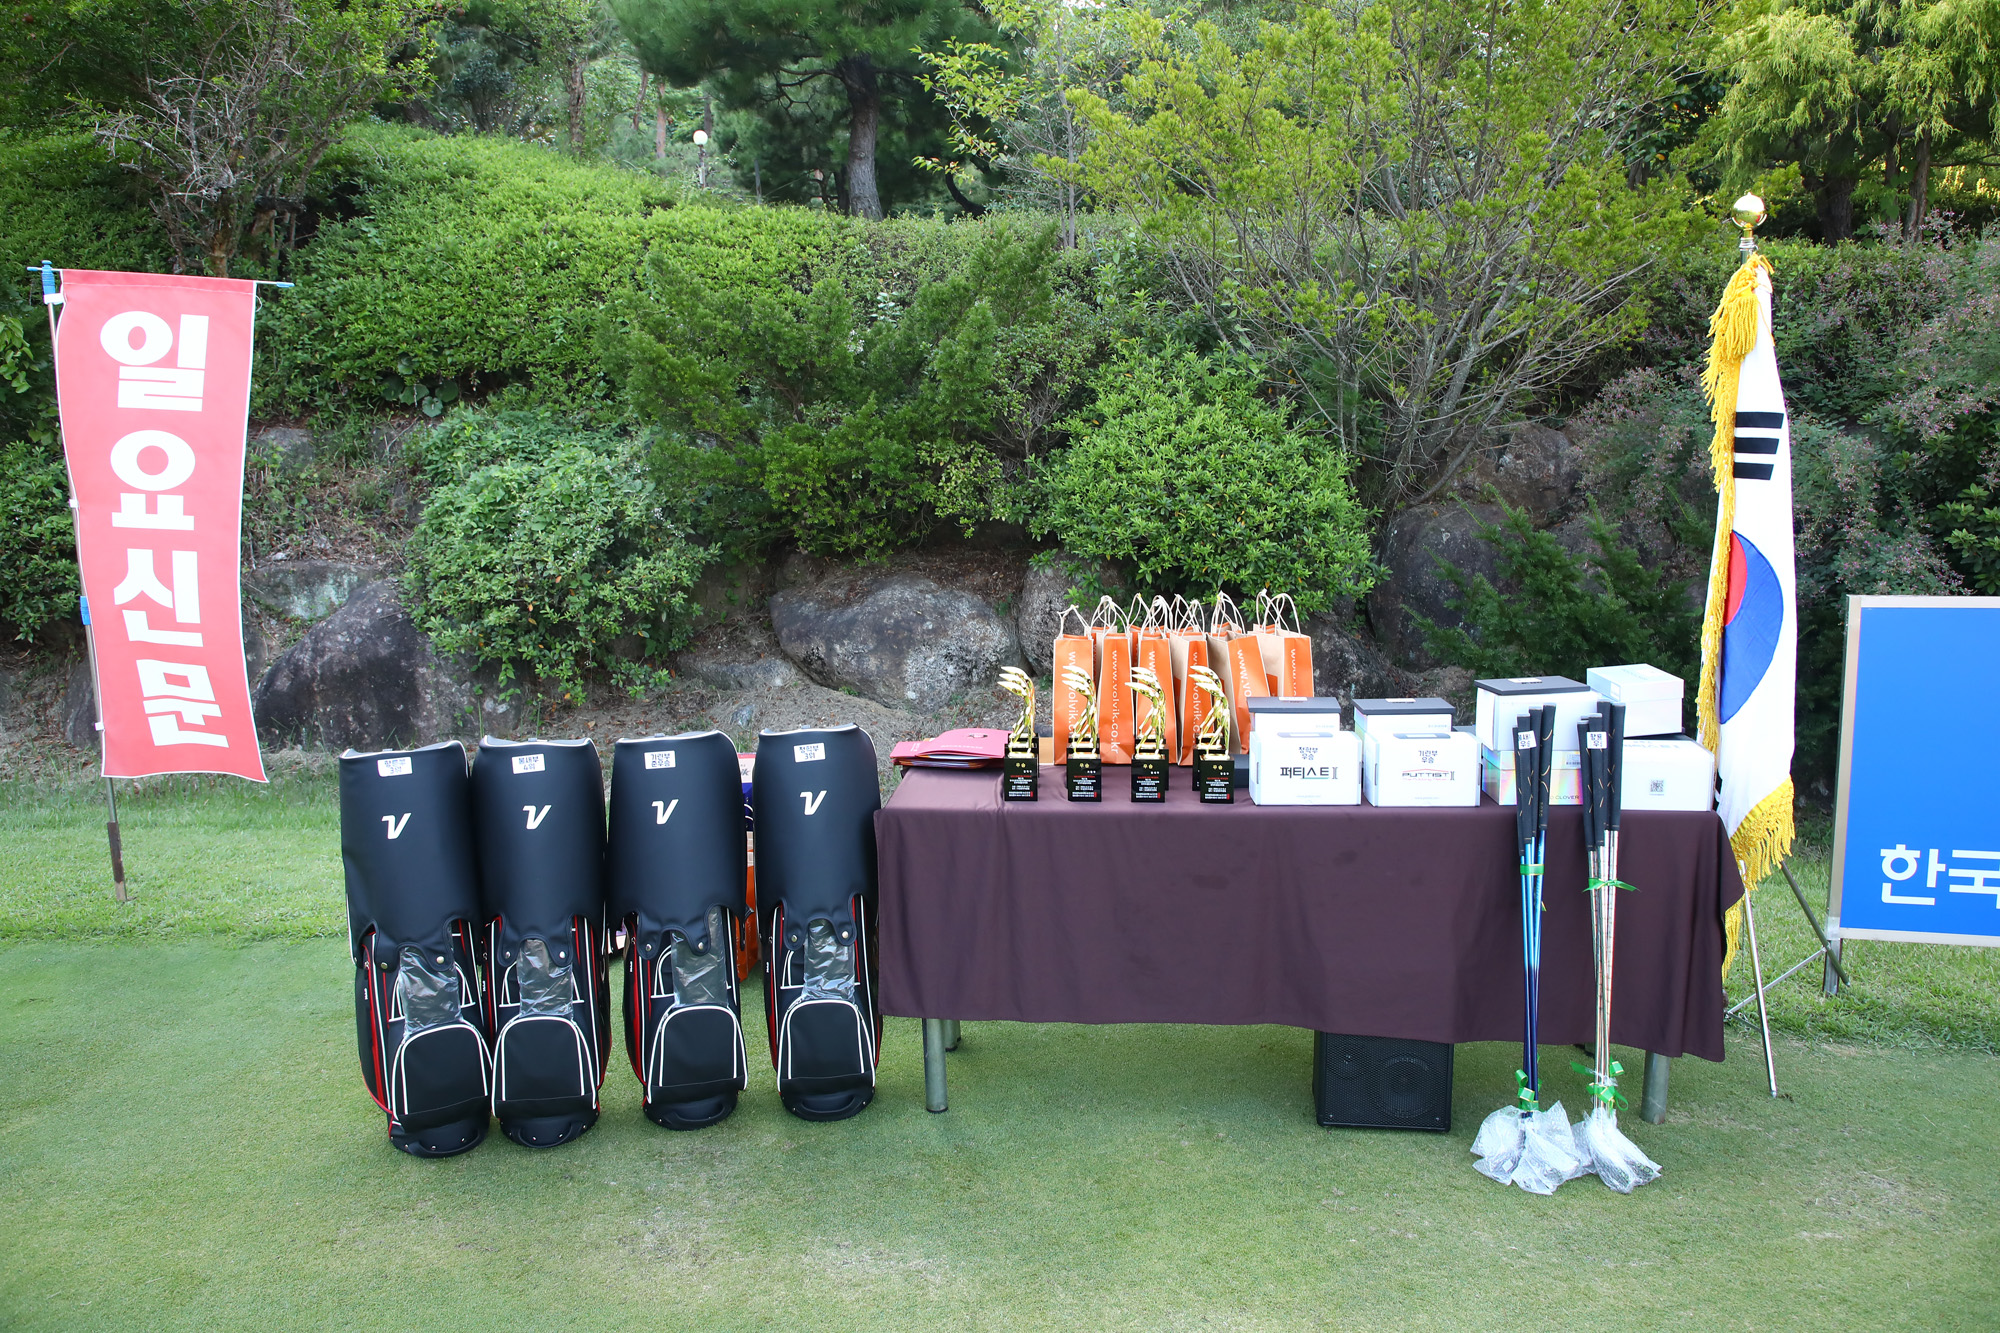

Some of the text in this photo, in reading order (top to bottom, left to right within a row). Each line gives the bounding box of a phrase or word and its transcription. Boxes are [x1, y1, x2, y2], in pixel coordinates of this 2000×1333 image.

[100, 310, 229, 748] 일요신문
[1110, 650, 1120, 754] www.volvik.co.kr
[1280, 767, 1329, 779] 퍼티스트
[1421, 756, 1434, 764] 우승
